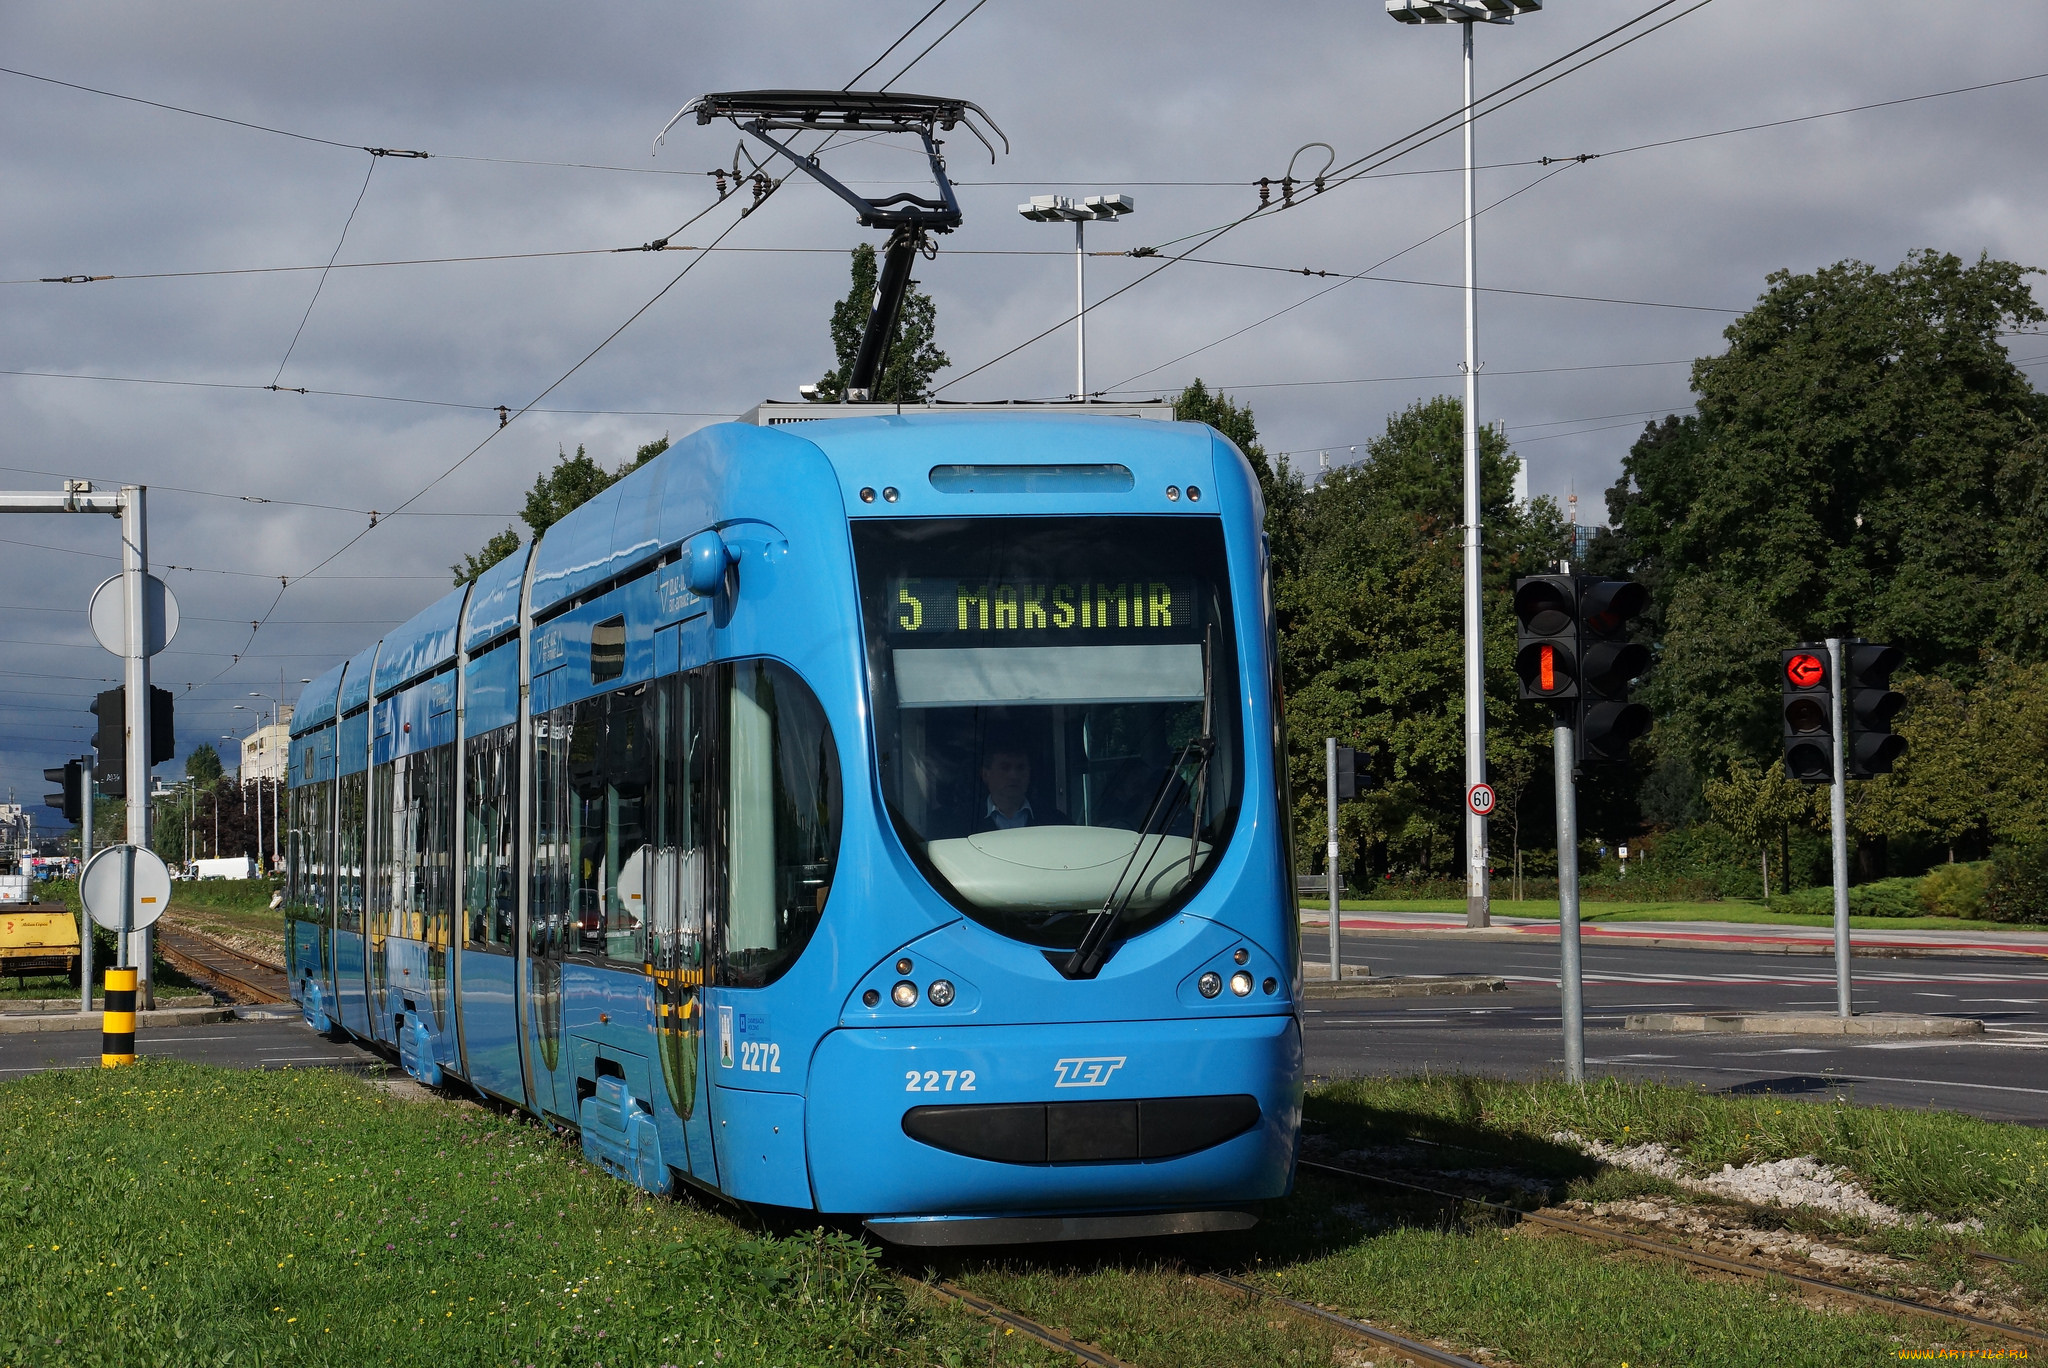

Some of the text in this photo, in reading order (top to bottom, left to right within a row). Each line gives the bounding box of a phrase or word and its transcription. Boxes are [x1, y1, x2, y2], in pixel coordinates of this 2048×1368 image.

[899, 578, 1172, 631] 5 MAKSIMIR
[1474, 791, 1490, 807] 60
[741, 1041, 781, 1073] 2272
[1053, 1055, 1128, 1088] ZET
[905, 1070, 977, 1092] 2272
